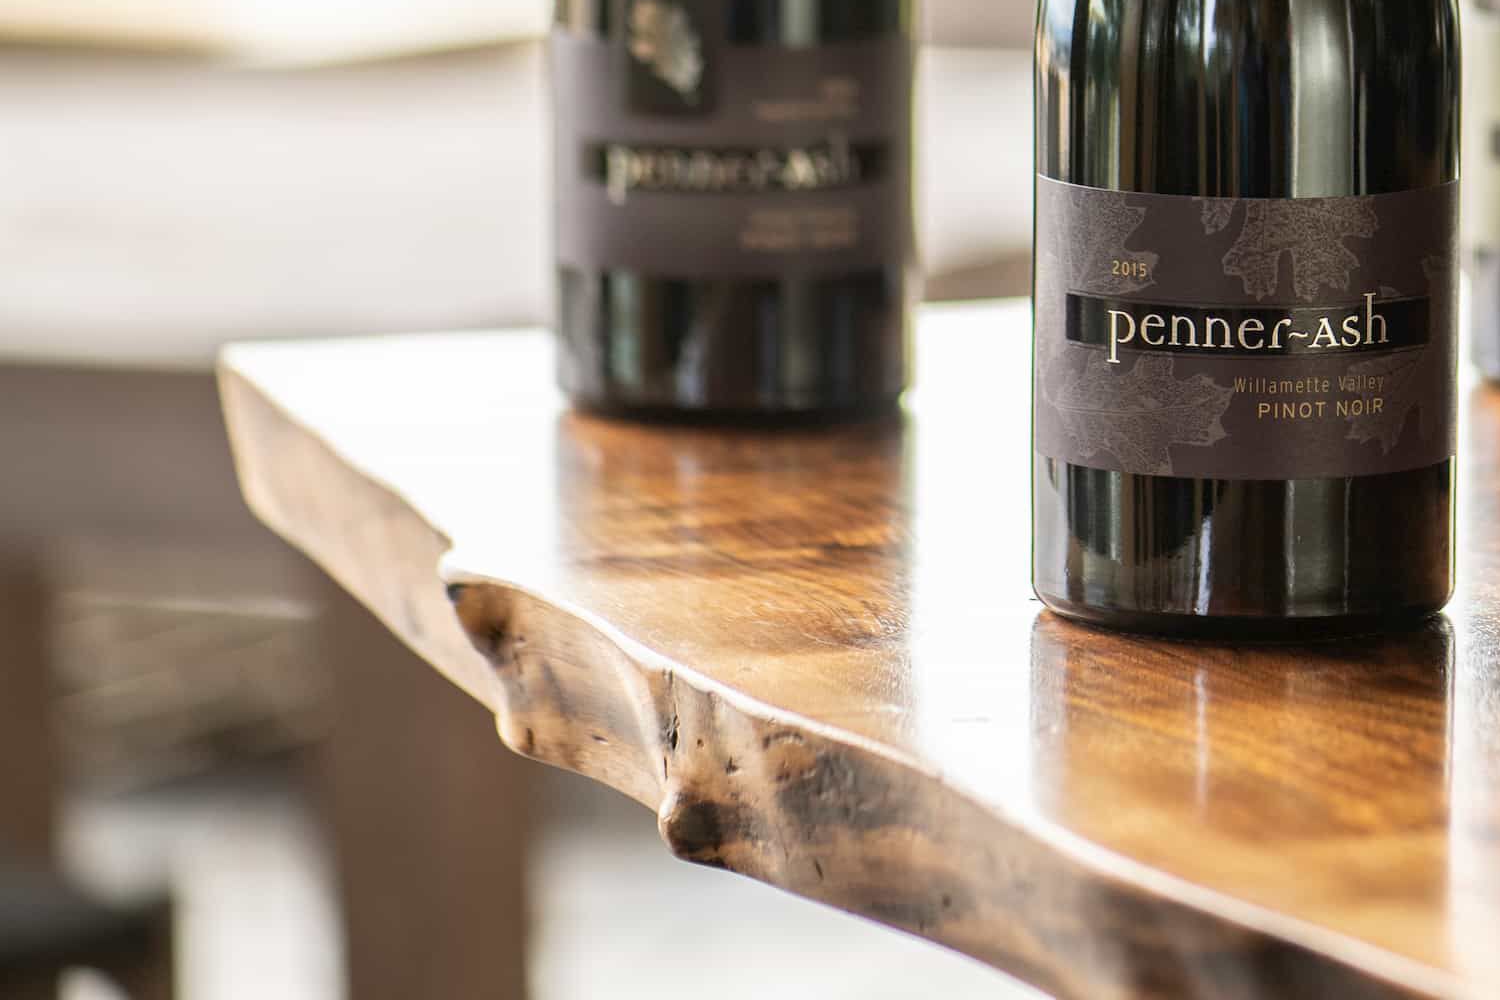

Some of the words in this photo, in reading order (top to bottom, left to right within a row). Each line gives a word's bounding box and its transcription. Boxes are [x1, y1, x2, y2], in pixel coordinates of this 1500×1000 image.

[1111, 260, 1148, 278] 2015
[1233, 376, 1330, 395] Willamette
[1338, 374, 1385, 393] Valley
[1257, 401, 1327, 420] PINOT
[1336, 397, 1385, 417] NOIR
